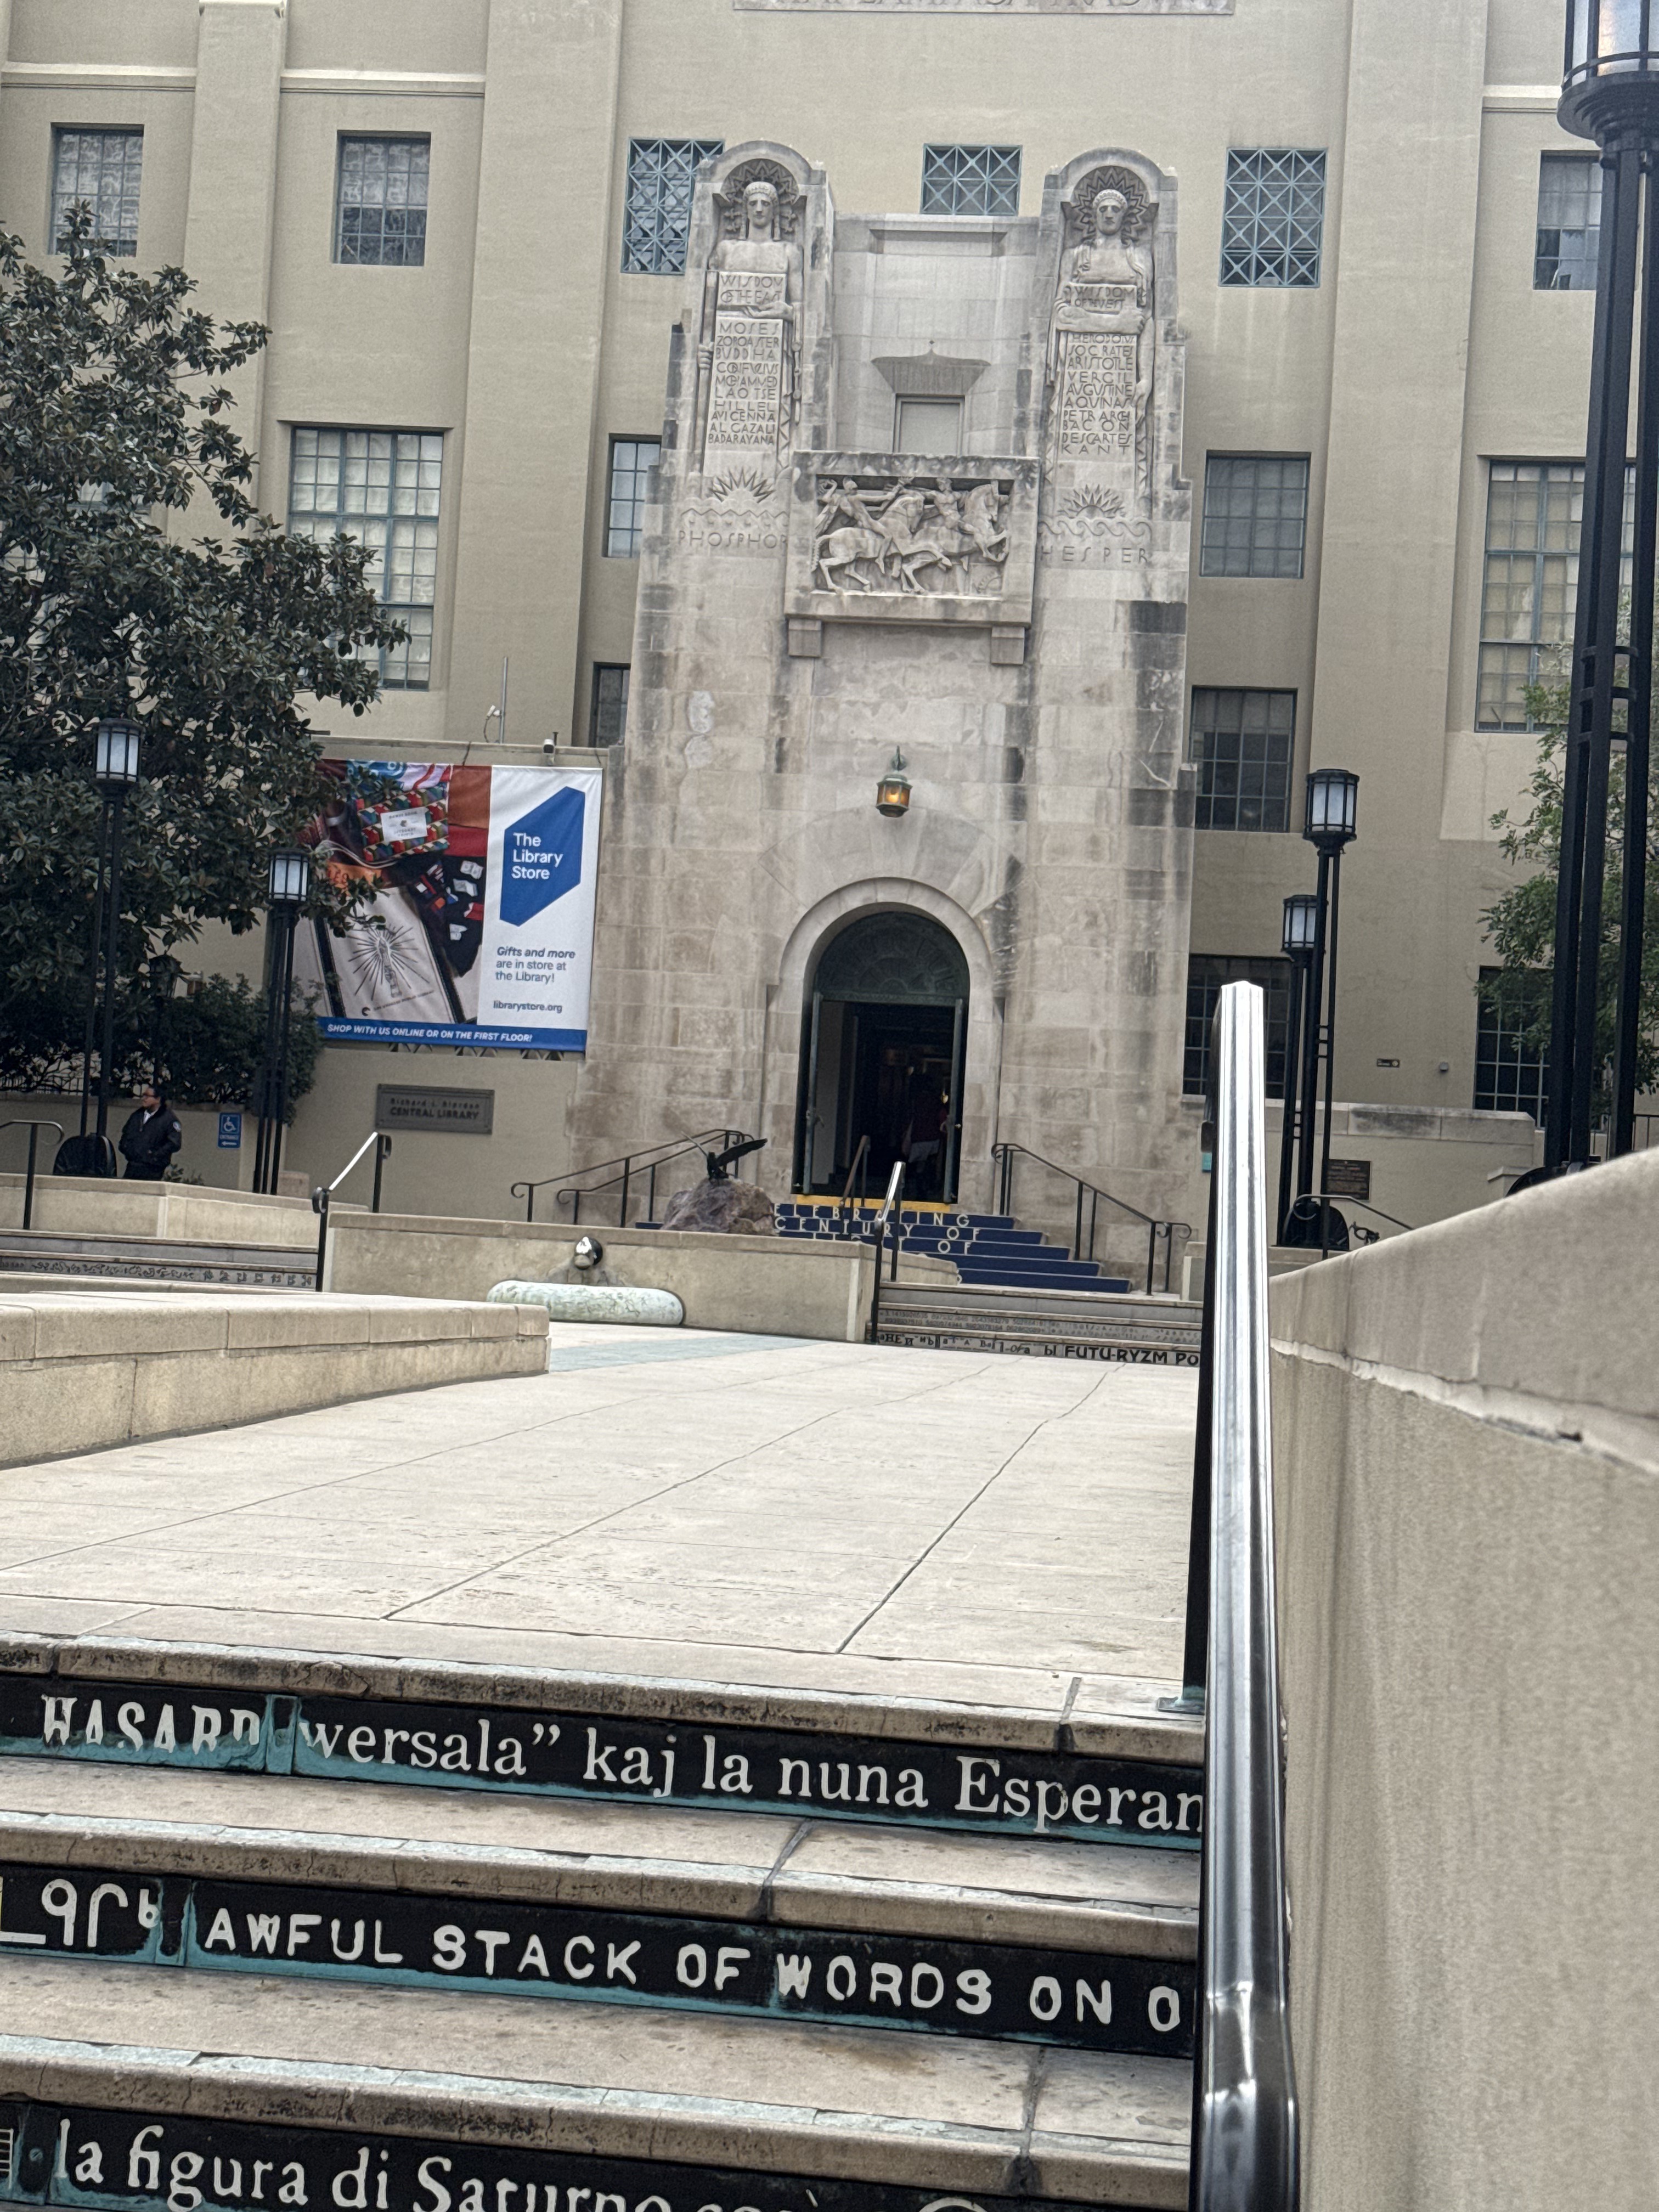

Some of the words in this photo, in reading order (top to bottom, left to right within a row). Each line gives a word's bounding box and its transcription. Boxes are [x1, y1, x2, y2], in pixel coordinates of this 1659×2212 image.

[720, 274, 783, 288] WISDOM
[719, 321, 779, 335] MOSES
[716, 335, 779, 348] ZOROASTER
[1068, 345, 1133, 356] SOCRATES
[1067, 356, 1133, 371] ARISTOTLE
[715, 387, 748, 399] LAO
[754, 387, 776, 400] TSE
[714, 400, 775, 412] HILLEL
[711, 410, 776, 422] AVICENNA
[1063, 409, 1130, 422] PETRARCH
[1063, 419, 1130, 432] BACON
[708, 433, 775, 445] BADARAYANA
[1062, 432, 1133, 445] DESCARTES
[1061, 444, 1130, 455] KANT
[1040, 545, 1148, 563] HESPER
[513, 832, 542, 847] The
[513, 849, 563, 868] Library
[511, 865, 550, 879] Store
[497, 946, 522, 957] Gifts
[524, 947, 546, 958] and
[547, 950, 576, 959] more
[496, 960, 512, 969] are
[515, 959, 524, 969] in
[527, 961, 554, 970] store
[556, 961, 567, 970] at
[495, 970, 512, 981] the
[516, 971, 555, 985] Library!
[493, 1000, 562, 1014] librarystore.org
[328, 1024, 352, 1033] SHOP
[354, 1025, 376, 1035] WITH
[379, 1027, 391, 1036] US
[392, 1028, 424, 1037] ONLINE
[426, 1029, 438, 1039] OR
[441, 1030, 453, 1039] ON
[455, 1030, 472, 1040] THE
[474, 1031, 498, 1041] FIRST
[500, 1032, 533, 1043] FLOOR!
[390, 1106, 435, 1118] CENTRAL
[438, 1109, 479, 1120] LIBRARY
[946, 1226, 980, 1240] OF
[938, 1239, 972, 1255] OF
[1064, 1345, 1167, 1364] FUTU-RYZM
[583, 1727, 676, 1798] kaj
[703, 1735, 753, 1794] la
[778, 1757, 928, 1809] nuna
[955, 1756, 1203, 1833] Esperan
[205, 1908, 403, 1963] AWFUL
[432, 1924, 641, 1984] STACK
[676, 1943, 751, 1990] OF
[776, 1953, 992, 2015] WORDS
[1030, 1976, 1111, 2024] ON
[55, 2118, 104, 2184] la
[127, 2125, 309, 2212] figura
[332, 2146, 388, 2209] di
